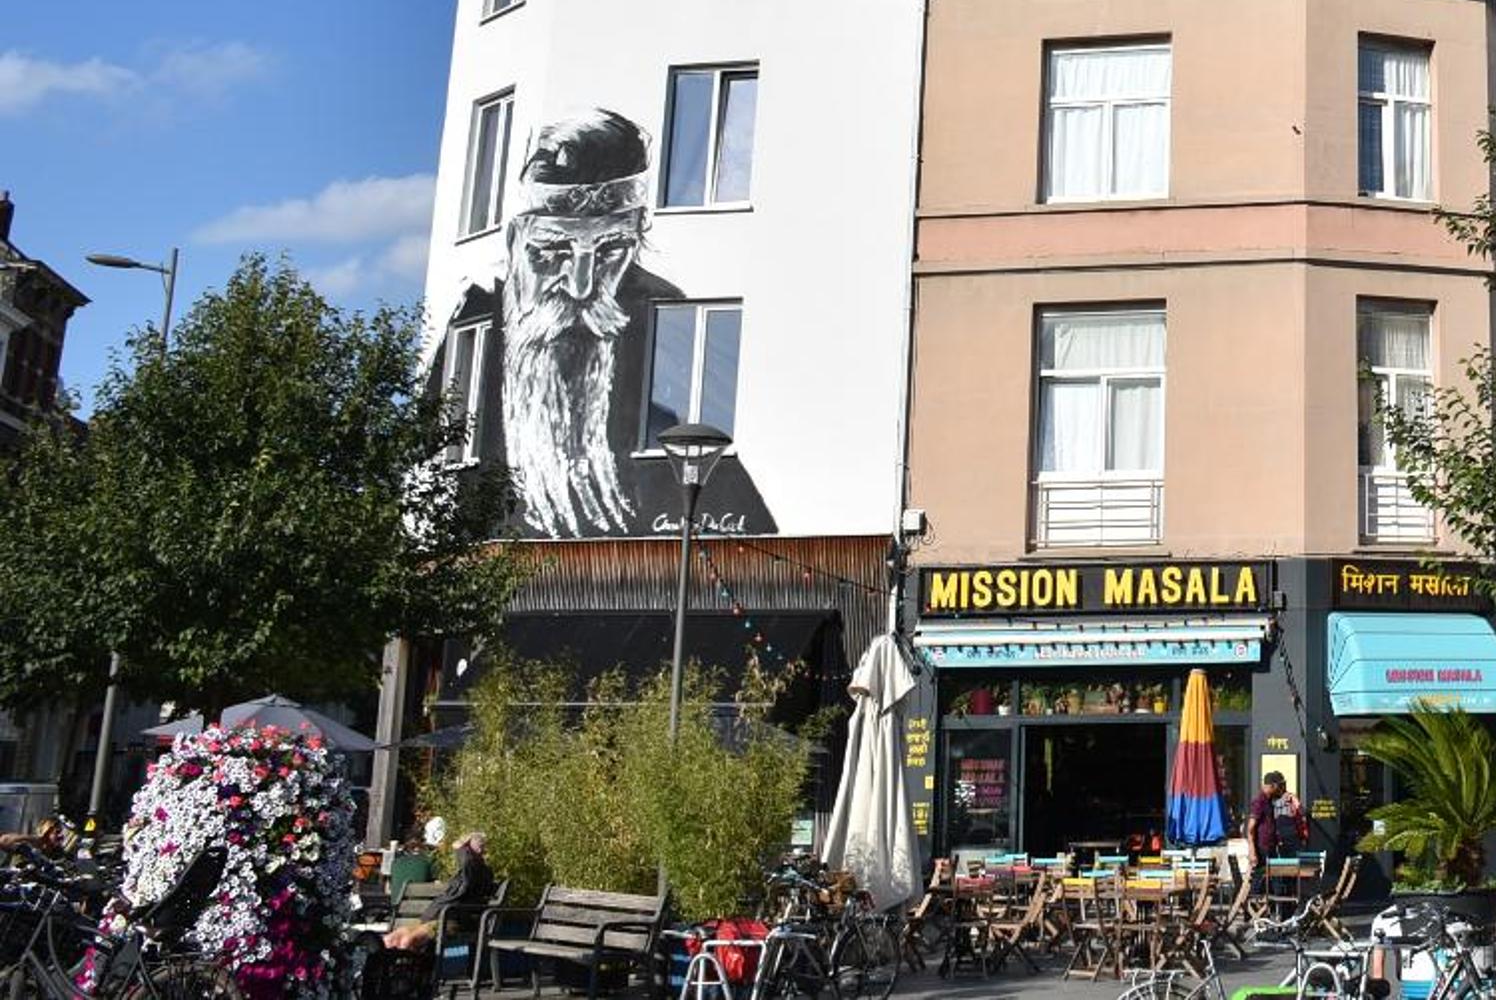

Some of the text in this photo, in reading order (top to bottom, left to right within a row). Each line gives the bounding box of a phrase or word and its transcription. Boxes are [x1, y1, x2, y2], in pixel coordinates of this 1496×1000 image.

[930, 566, 1257, 608] MISSION MASALA
[1341, 564, 1400, 594] मिशन
